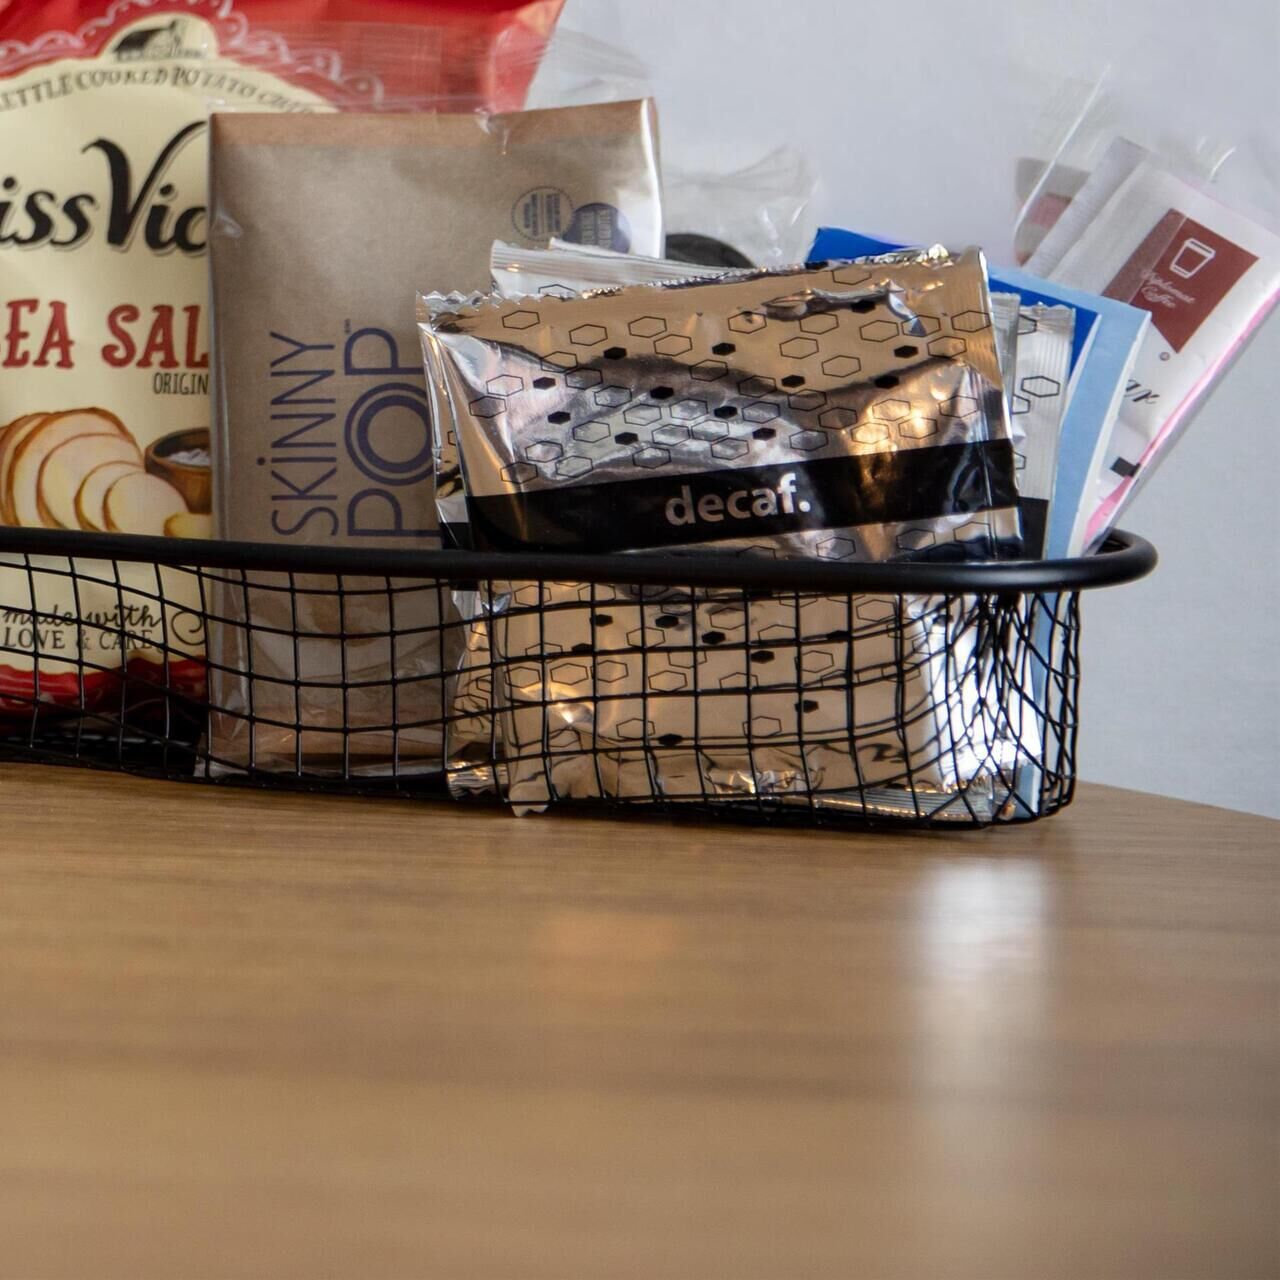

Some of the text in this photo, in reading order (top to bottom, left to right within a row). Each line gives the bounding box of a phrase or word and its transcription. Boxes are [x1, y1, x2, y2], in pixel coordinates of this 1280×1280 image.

[75, 67, 169, 91] COOKED
[171, 67, 258, 98] POTATO
[257, 331, 339, 536] SKINNY
[344, 327, 442, 537] POP
[665, 472, 811, 526] decaf.
[2, 604, 162, 629] made with
[4, 627, 66, 649] LOVE
[100, 629, 154, 651] CARE
